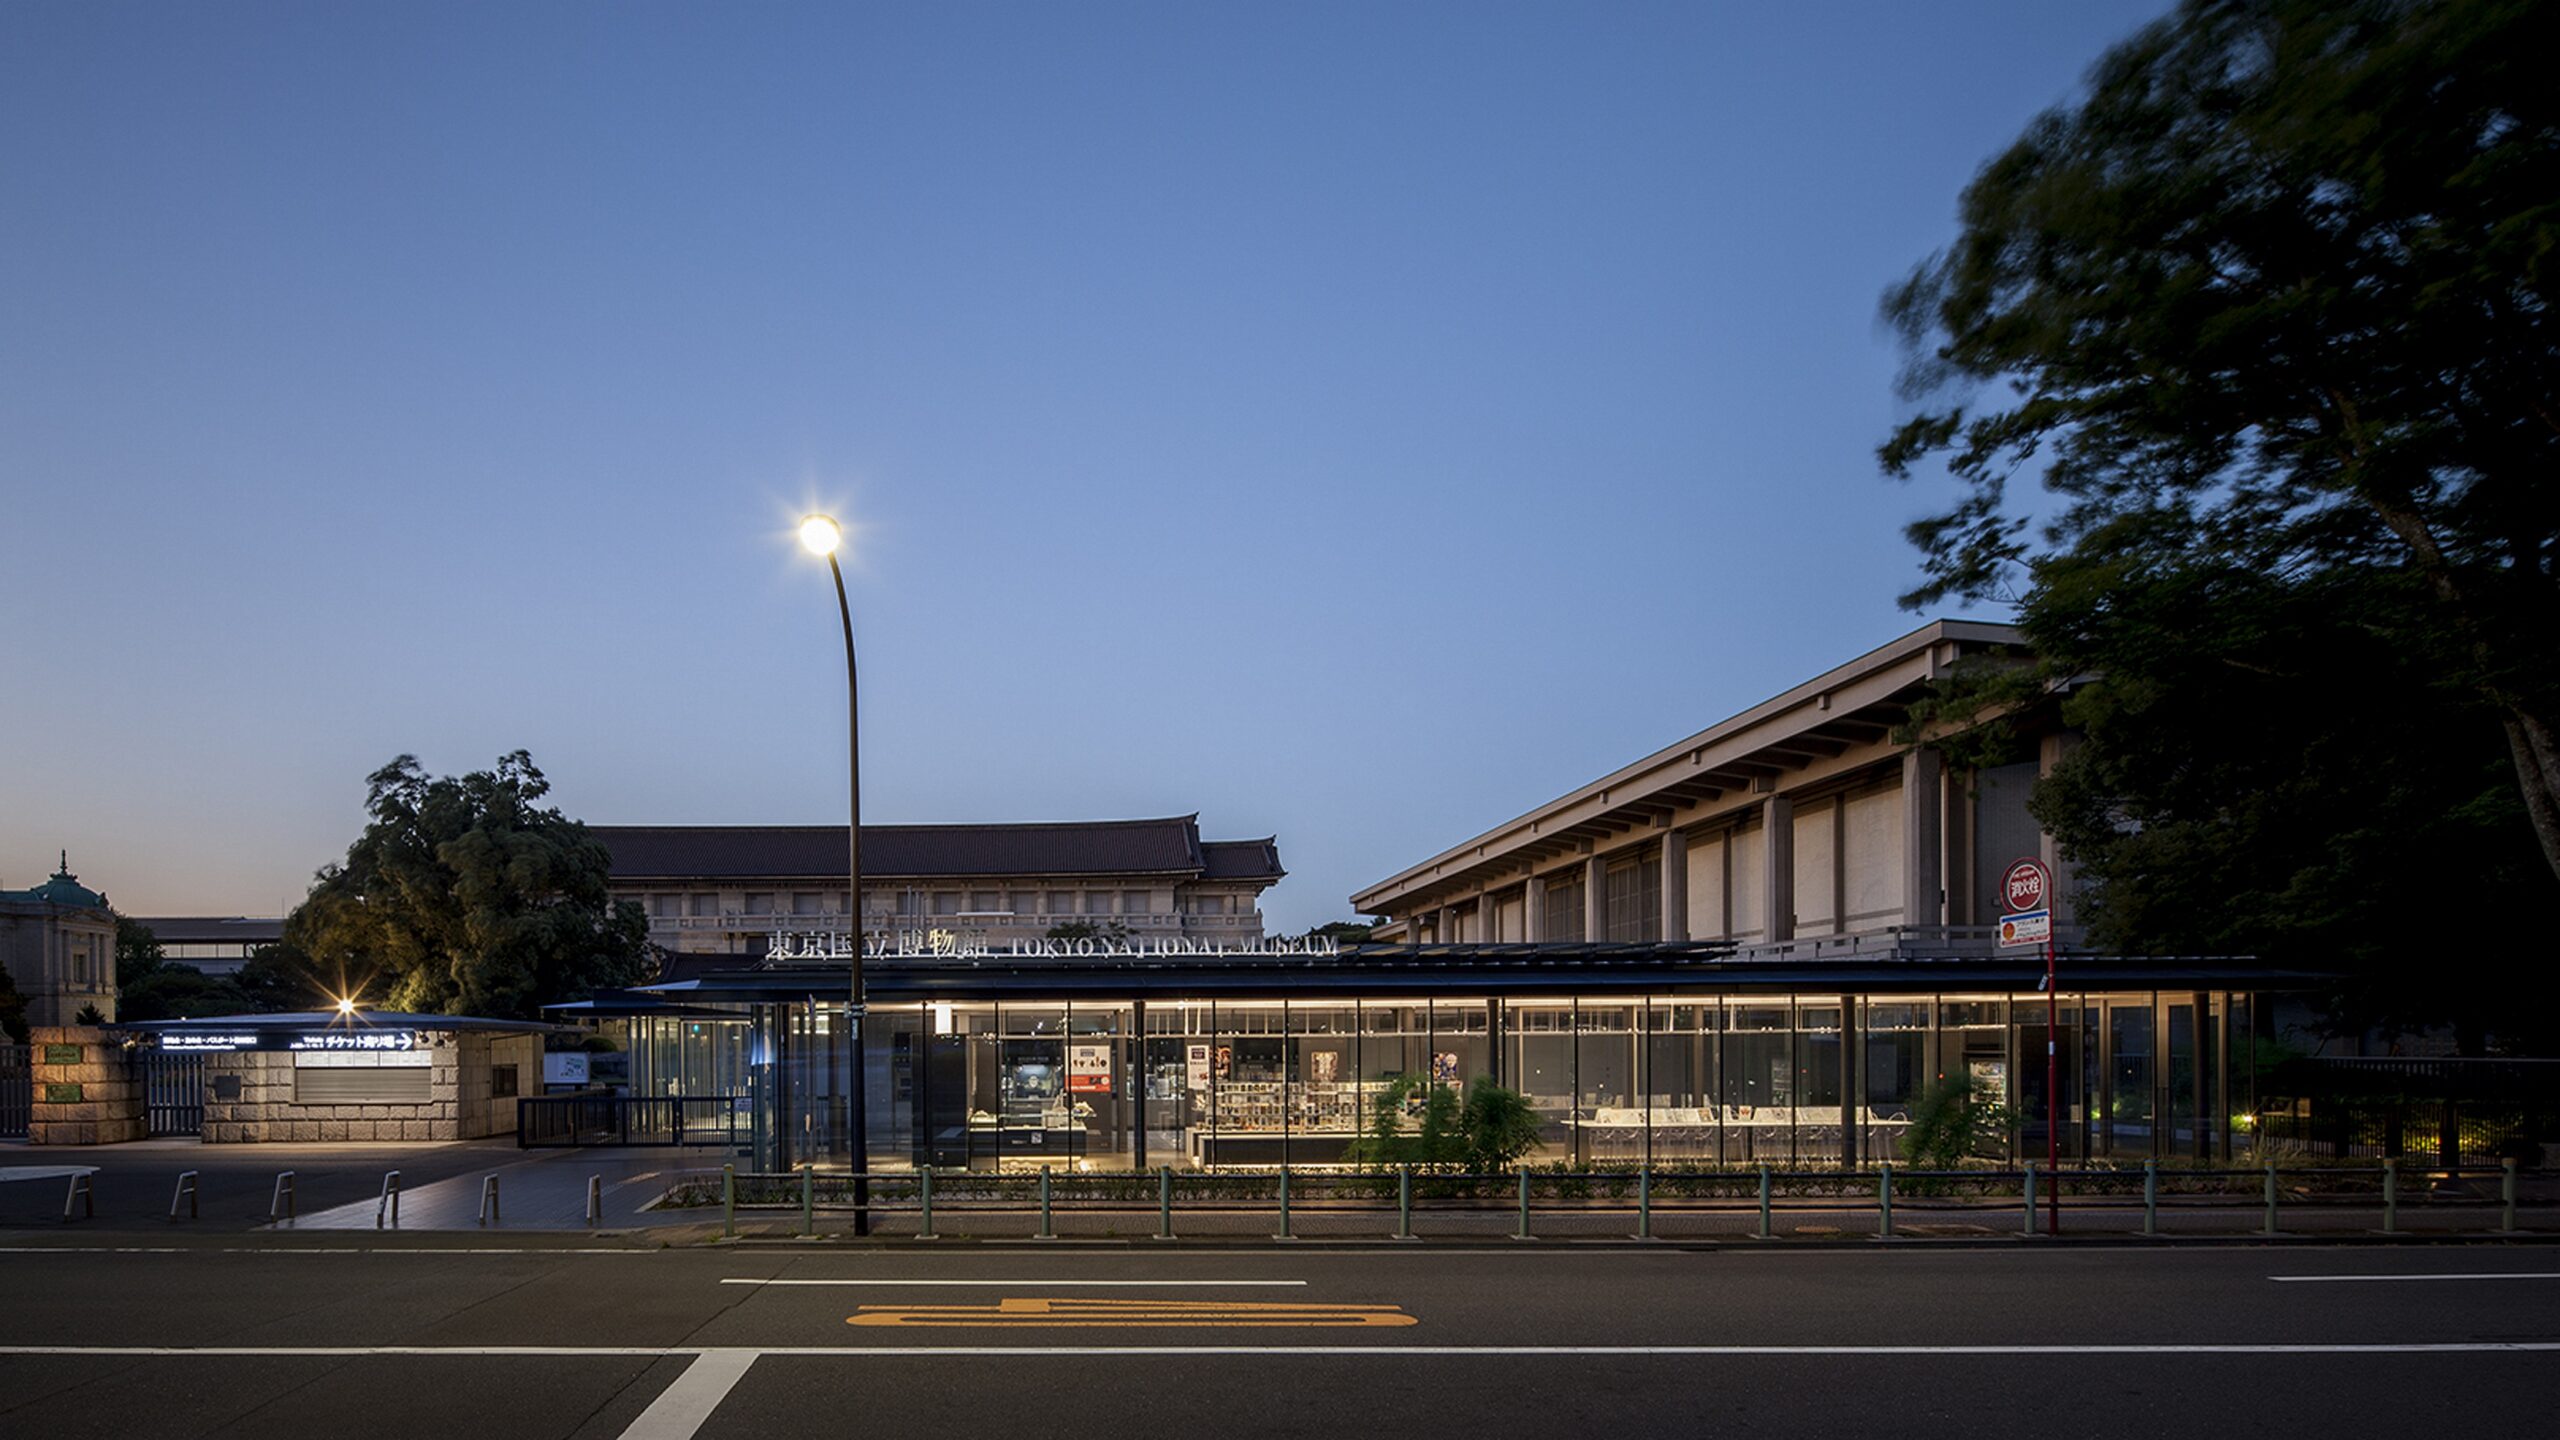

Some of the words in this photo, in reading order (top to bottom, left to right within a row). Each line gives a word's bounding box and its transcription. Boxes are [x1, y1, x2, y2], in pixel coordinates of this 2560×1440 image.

[2011, 877, 2040, 898] 消火栓
[765, 929, 989, 957] 東京国立博物館
[1008, 936, 1095, 956] TOKYO
[1099, 936, 1230, 956] NATIONAL
[1238, 935, 1339, 956] MUSEUM
